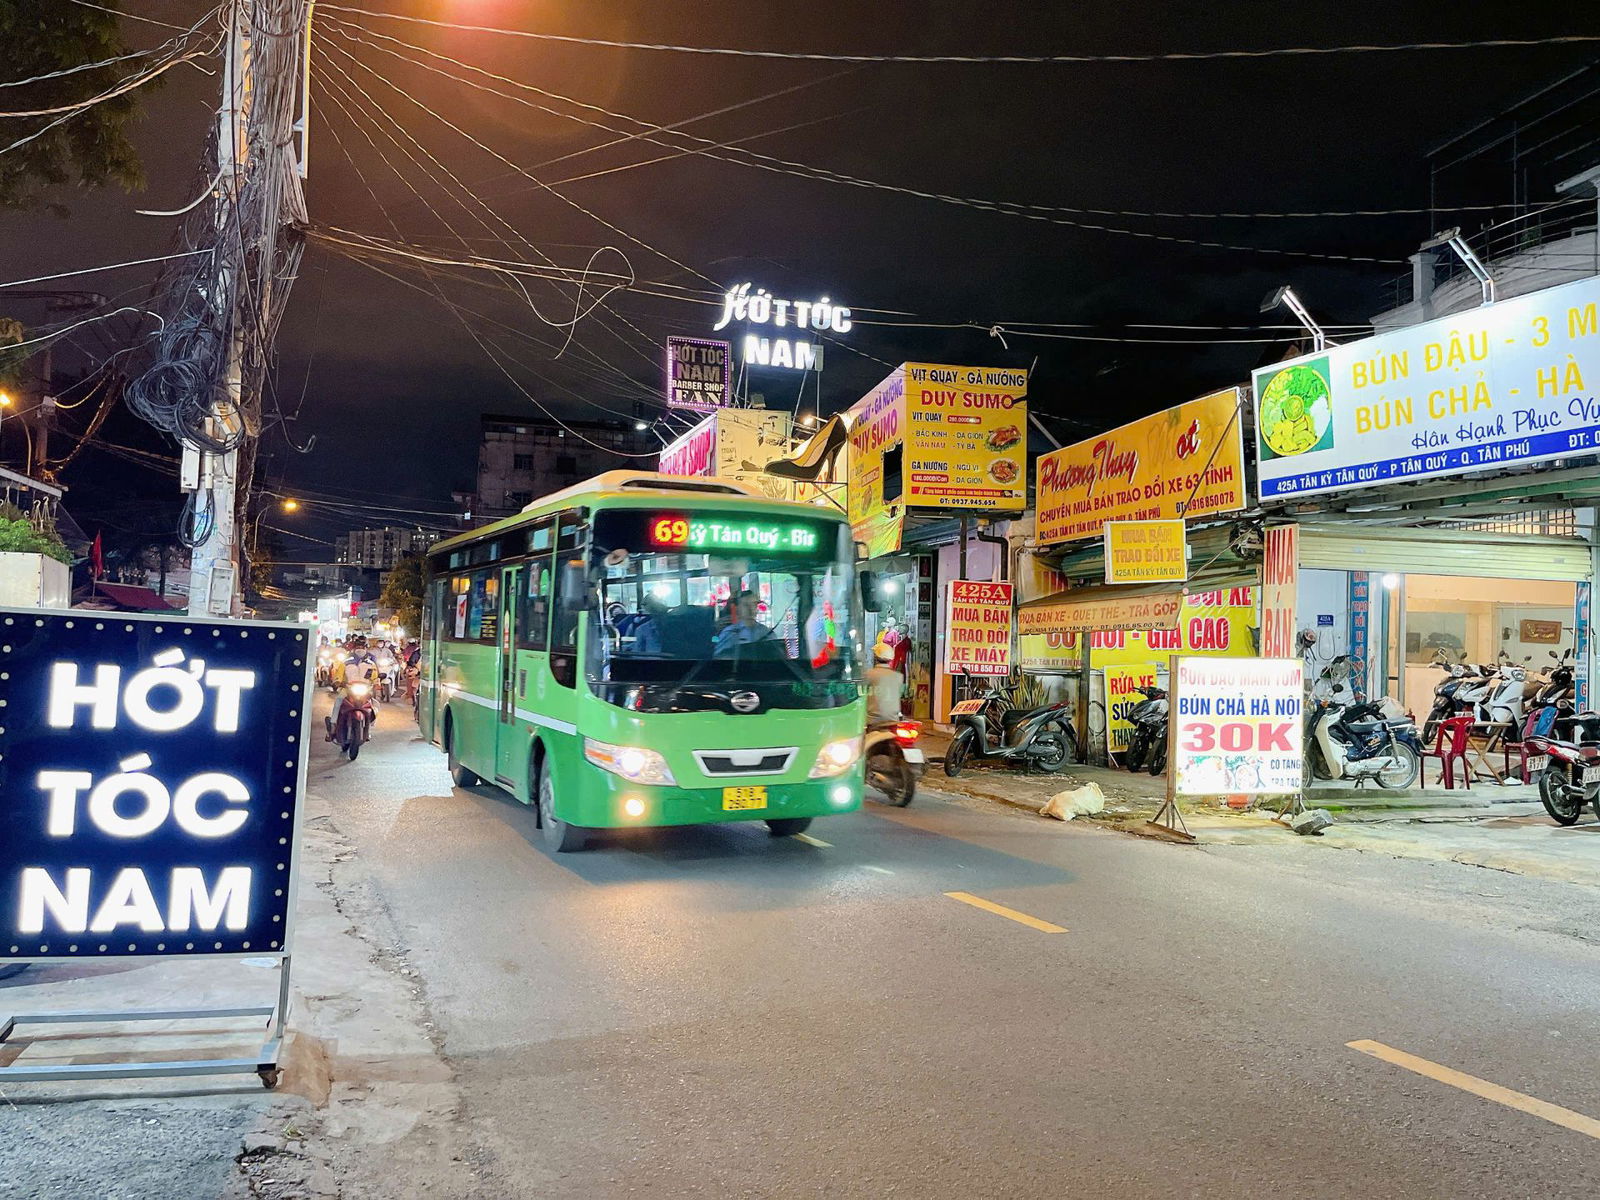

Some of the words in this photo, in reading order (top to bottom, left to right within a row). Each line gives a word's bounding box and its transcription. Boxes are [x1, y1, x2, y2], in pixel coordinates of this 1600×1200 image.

[713, 282, 790, 330] HỚT
[794, 297, 851, 332] TÓC
[672, 343, 697, 362] HỚT
[701, 346, 725, 365] TÓC
[745, 335, 823, 371] NAM
[1352, 350, 1408, 389] BÚN
[1424, 329, 1488, 372] ĐẬU
[1531, 316, 1549, 347] 3
[677, 363, 720, 382] NAM
[911, 368, 927, 384] VỊT
[930, 369, 958, 383] QUAY
[967, 369, 983, 385] GÀ
[986, 370, 1024, 386] NƯỚNG
[672, 380, 702, 390] BARBER
[704, 383, 725, 392] SHOP
[675, 389, 722, 404] FAN
[1356, 396, 1413, 434] BÚN
[1428, 371, 1492, 420] CHẢ
[1536, 354, 1584, 399] HÀ
[921, 390, 957, 407] DUY
[963, 392, 1015, 410] SUMO
[871, 408, 897, 449] SUMO
[925, 412, 942, 422] QUAY
[1412, 429, 1449, 449] Hân
[1456, 414, 1507, 443] Hạnh
[1512, 408, 1561, 432] Phục
[1277, 480, 1298, 492] 425A
[1300, 475, 1317, 488] TÂN
[1321, 471, 1332, 486] KỲ
[1336, 469, 1355, 483] TÂN
[1358, 464, 1378, 479] QUÝ
[1391, 463, 1398, 475] P
[1401, 458, 1422, 473] TÂN
[1425, 453, 1448, 469] QUÝ
[1461, 452, 1473, 464] Q.
[1478, 446, 1500, 461] TÂN
[1506, 439, 1530, 457] PHÚ
[1569, 434, 1589, 448] ĐT:
[1040, 503, 1071, 523] CHUYÊN
[1073, 500, 1092, 515] MUA
[1094, 491, 1114, 510] BÁN
[1116, 488, 1141, 505] TRAO
[1144, 475, 1164, 499] ĐỔI
[1168, 477, 1182, 494] XE
[1186, 473, 1201, 489] 63
[1204, 464, 1233, 486] TỈNH
[655, 519, 688, 543] 69
[709, 525, 742, 543] Tân
[746, 527, 779, 548] Quý
[1121, 529, 1146, 543] MUA
[1149, 526, 1171, 543] BÁN
[1114, 548, 1142, 563] TRAO
[1146, 544, 1163, 562] ĐỔI
[1167, 548, 1180, 562] XE
[1266, 528, 1293, 585] MUA
[1115, 568, 1131, 576] 425A
[1133, 567, 1145, 576] TÂN
[956, 584, 1007, 599] 425A
[953, 607, 980, 622] MUA
[983, 606, 1009, 624] BÁN
[1055, 611, 1066, 622] XE
[1153, 598, 1179, 616] GÓP
[952, 628, 983, 643] TRAO
[987, 625, 1008, 644] ĐỔI
[1189, 617, 1229, 649] CAO
[1264, 591, 1291, 658] BÁN
[952, 646, 970, 661] XE
[975, 645, 1007, 662] MÁY
[981, 664, 993, 672] 850
[49, 647, 255, 732] HỚT
[1110, 672, 1135, 695] RỬA
[1180, 693, 1210, 715] BÚN
[1216, 692, 1245, 715] CHẢ
[1251, 694, 1270, 715] HÀ
[1275, 695, 1300, 720] NỘI
[1182, 723, 1294, 752] 30K
[37, 752, 250, 838] TÓC
[19, 867, 251, 933] NAM
